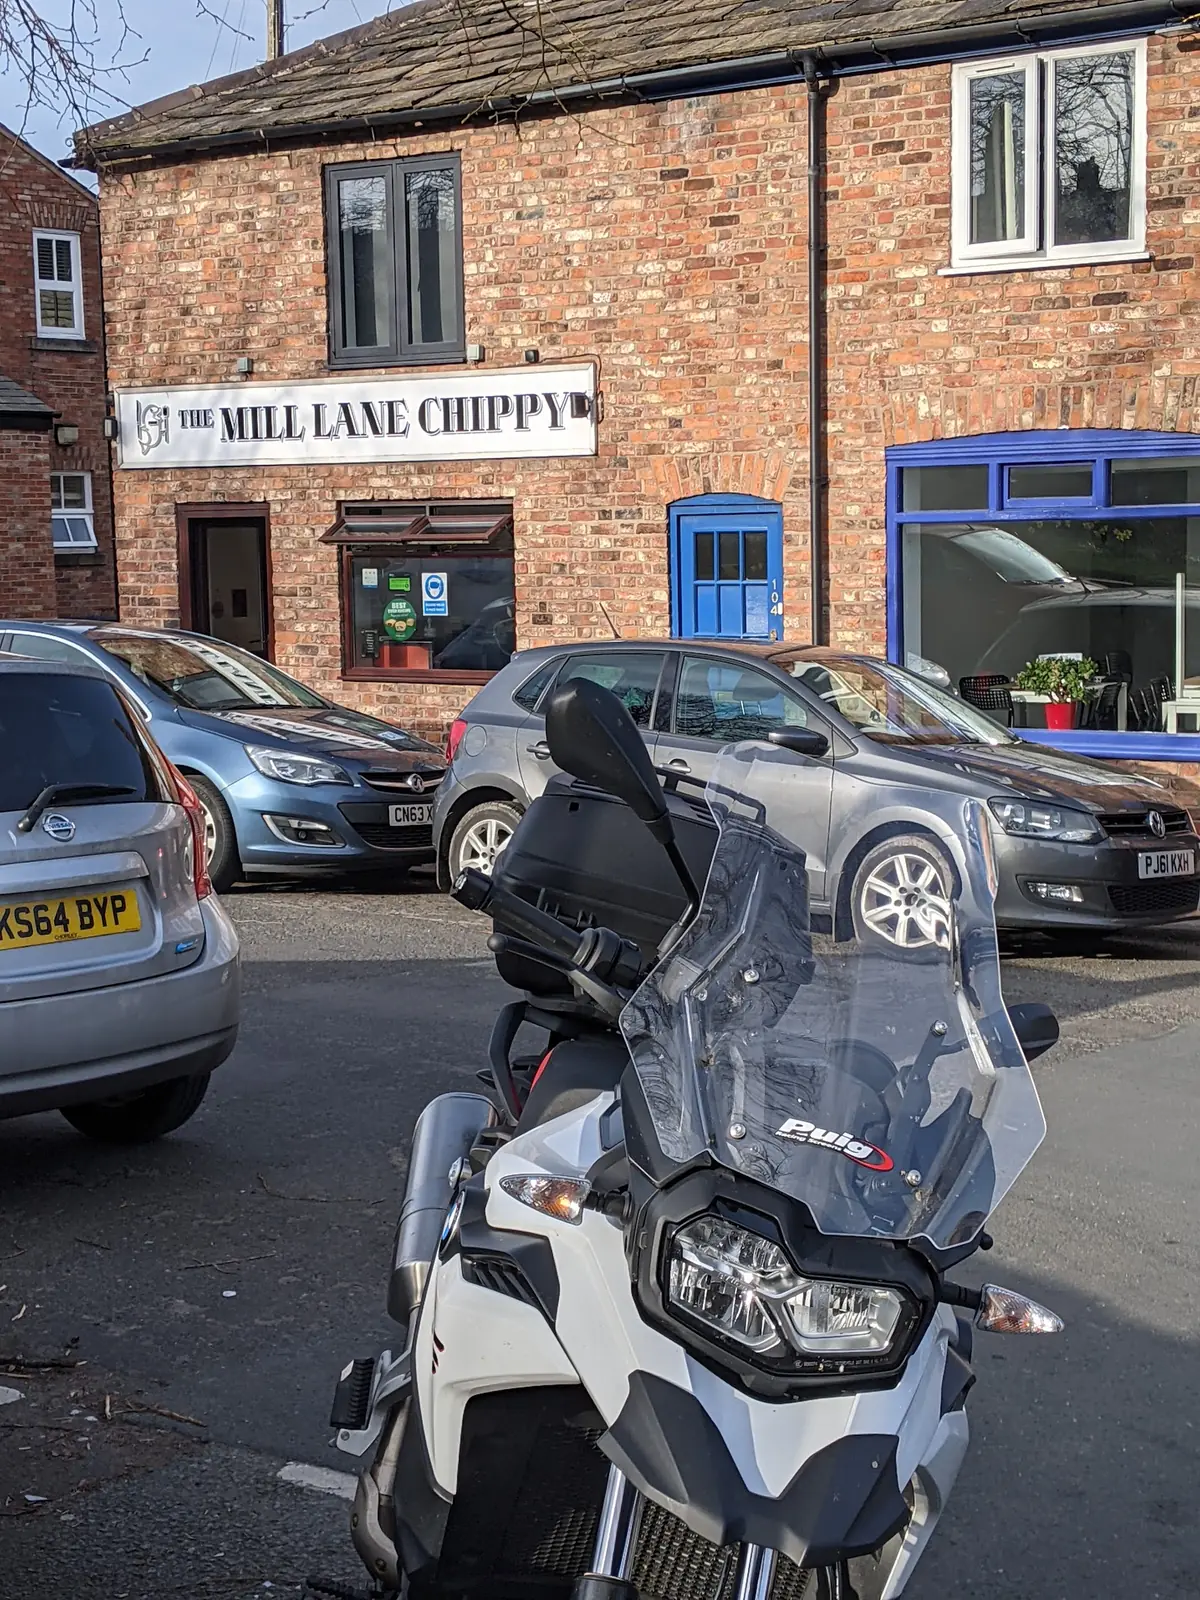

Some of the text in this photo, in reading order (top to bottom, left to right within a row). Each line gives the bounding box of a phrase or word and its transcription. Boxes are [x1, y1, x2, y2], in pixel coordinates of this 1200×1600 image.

[178, 391, 569, 443] THE MILL LANE CHIPPY
[394, 806, 424, 823] CN63
[1145, 852, 1189, 875] PJ61 KXH
[0, 894, 126, 941] KS64 BYP
[775, 1130, 843, 1151] Racing Screens
[776, 1117, 873, 1159] Puig
